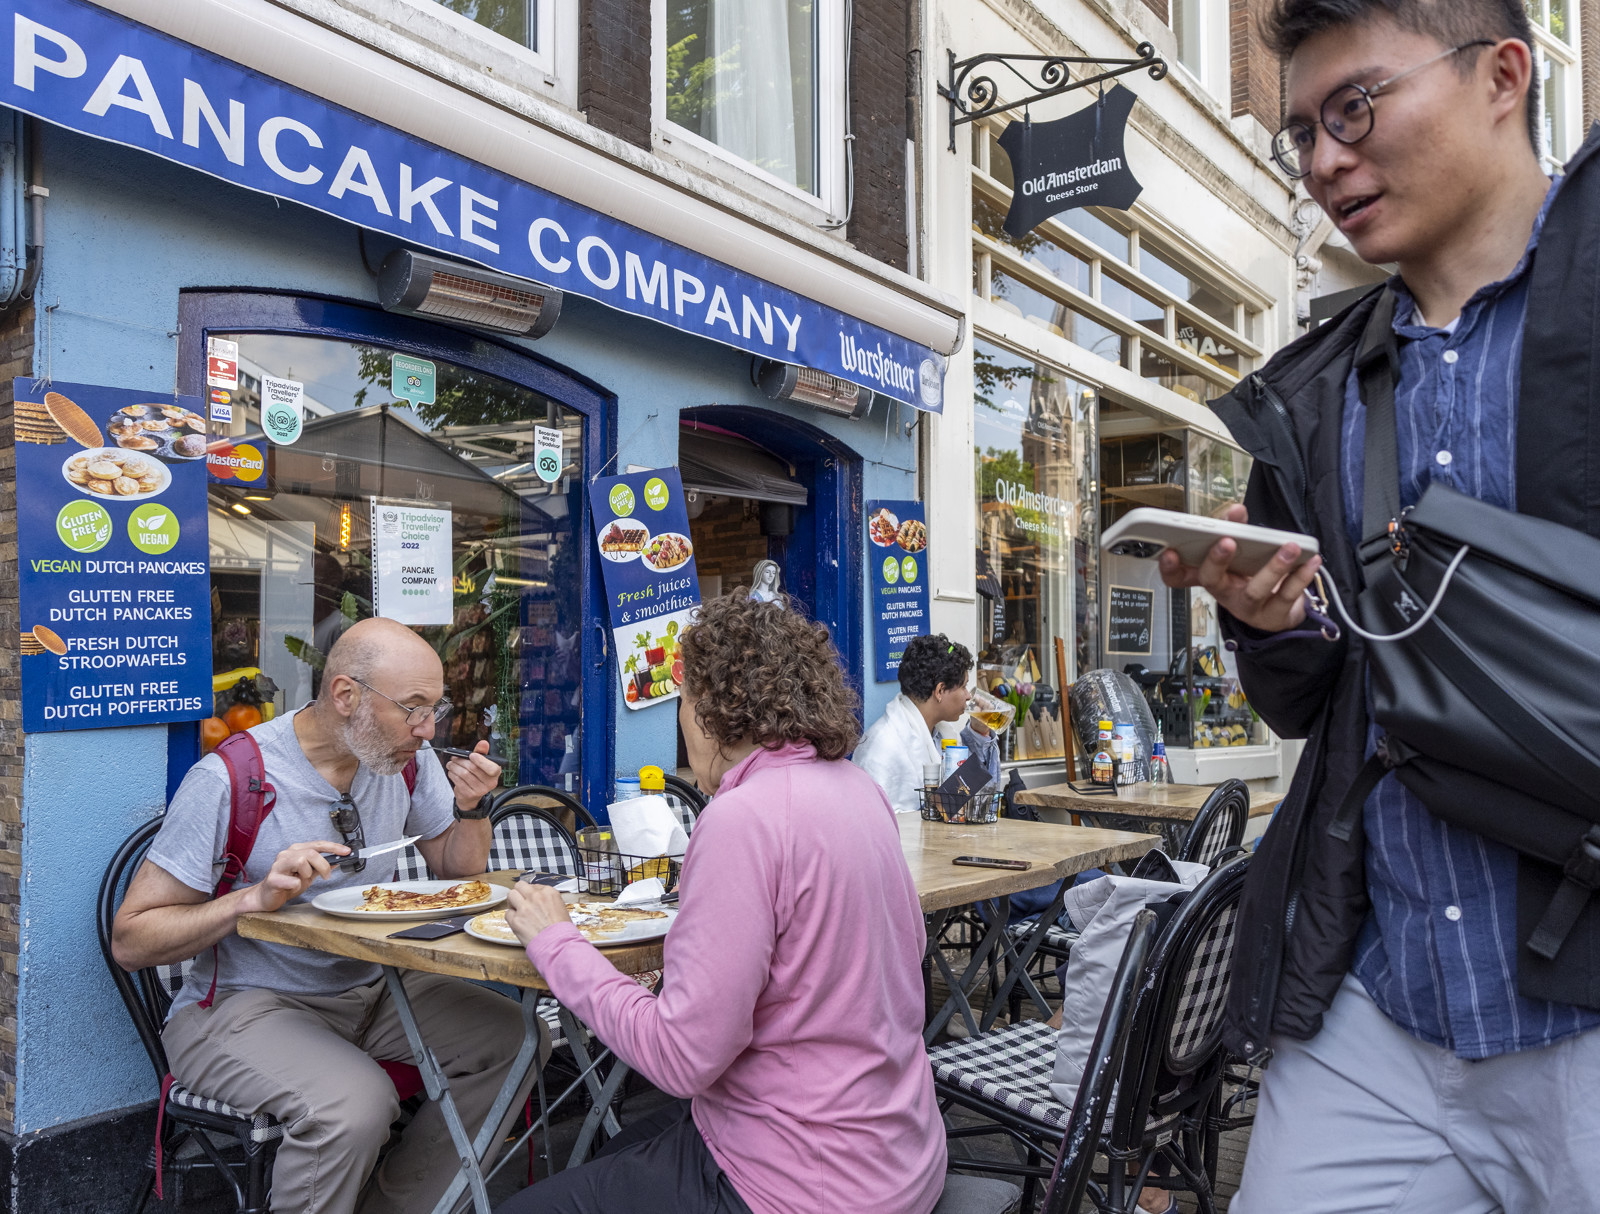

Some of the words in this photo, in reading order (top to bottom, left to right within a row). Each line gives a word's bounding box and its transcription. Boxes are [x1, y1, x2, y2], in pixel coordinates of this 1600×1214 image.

[14, 12, 500, 255] PANCAKE
[527, 217, 802, 352] COMPANY
[1022, 176, 1046, 196] Old
[1046, 157, 1122, 190] Amsterdam
[1045, 189, 1075, 203] Cheese
[1075, 183, 1099, 195] Store
[839, 330, 915, 394] Warsteiner
[423, 366, 433, 375] ONS
[265, 379, 301, 393] Tripadvisor
[267, 386, 299, 399] Travellers'
[270, 393, 294, 404] Choice
[214, 407, 231, 417] VISA
[206, 453, 263, 470] MasterCard
[611, 488, 630, 504] GLUTEN
[650, 496, 666, 506] VEGAN
[995, 478, 1016, 507] Old
[1016, 483, 1075, 519] Amsterdam
[616, 497, 628, 511] FREE
[61, 510, 103, 529] GLUTEN
[401, 512, 444, 523] Tripadvisor
[71, 522, 97, 542] FREE
[401, 521, 441, 532] Travellers'
[1015, 517, 1040, 533] Cheese
[1041, 522, 1060, 537] Store
[139, 533, 169, 545] VEGAN
[401, 531, 430, 541] Choice
[31, 559, 81, 573] VEGAN
[85, 560, 134, 574] DUTCH
[138, 561, 206, 575] PANCAKES
[401, 566, 435, 574] PANCAKE
[401, 576, 437, 585] COMPANY
[68, 589, 132, 603] GLUTEN
[137, 590, 175, 603] FREE
[617, 584, 654, 607] Fresh
[656, 577, 691, 600] juices
[881, 587, 898, 595] VEGAN
[898, 585, 922, 594] PANCAKES
[621, 611, 632, 623] &
[635, 594, 693, 620] smoothies
[886, 602, 905, 611] GLUTEN
[906, 601, 918, 609] FREE
[50, 608, 107, 622] DUTCH
[113, 607, 193, 621] PANCAKES
[882, 611, 899, 620] DUTCH
[899, 609, 923, 619] PANCAKES
[887, 626, 906, 635] GLUTEN
[907, 625, 919, 633] FREE
[67, 637, 119, 651] FRESH
[126, 635, 179, 650] DUTCH
[58, 653, 187, 670] STROOPWAFELS
[69, 683, 134, 700] GLUTEN
[140, 681, 179, 696] FREE
[44, 703, 102, 720] DUTCH
[108, 697, 202, 716] POFFERTJES
